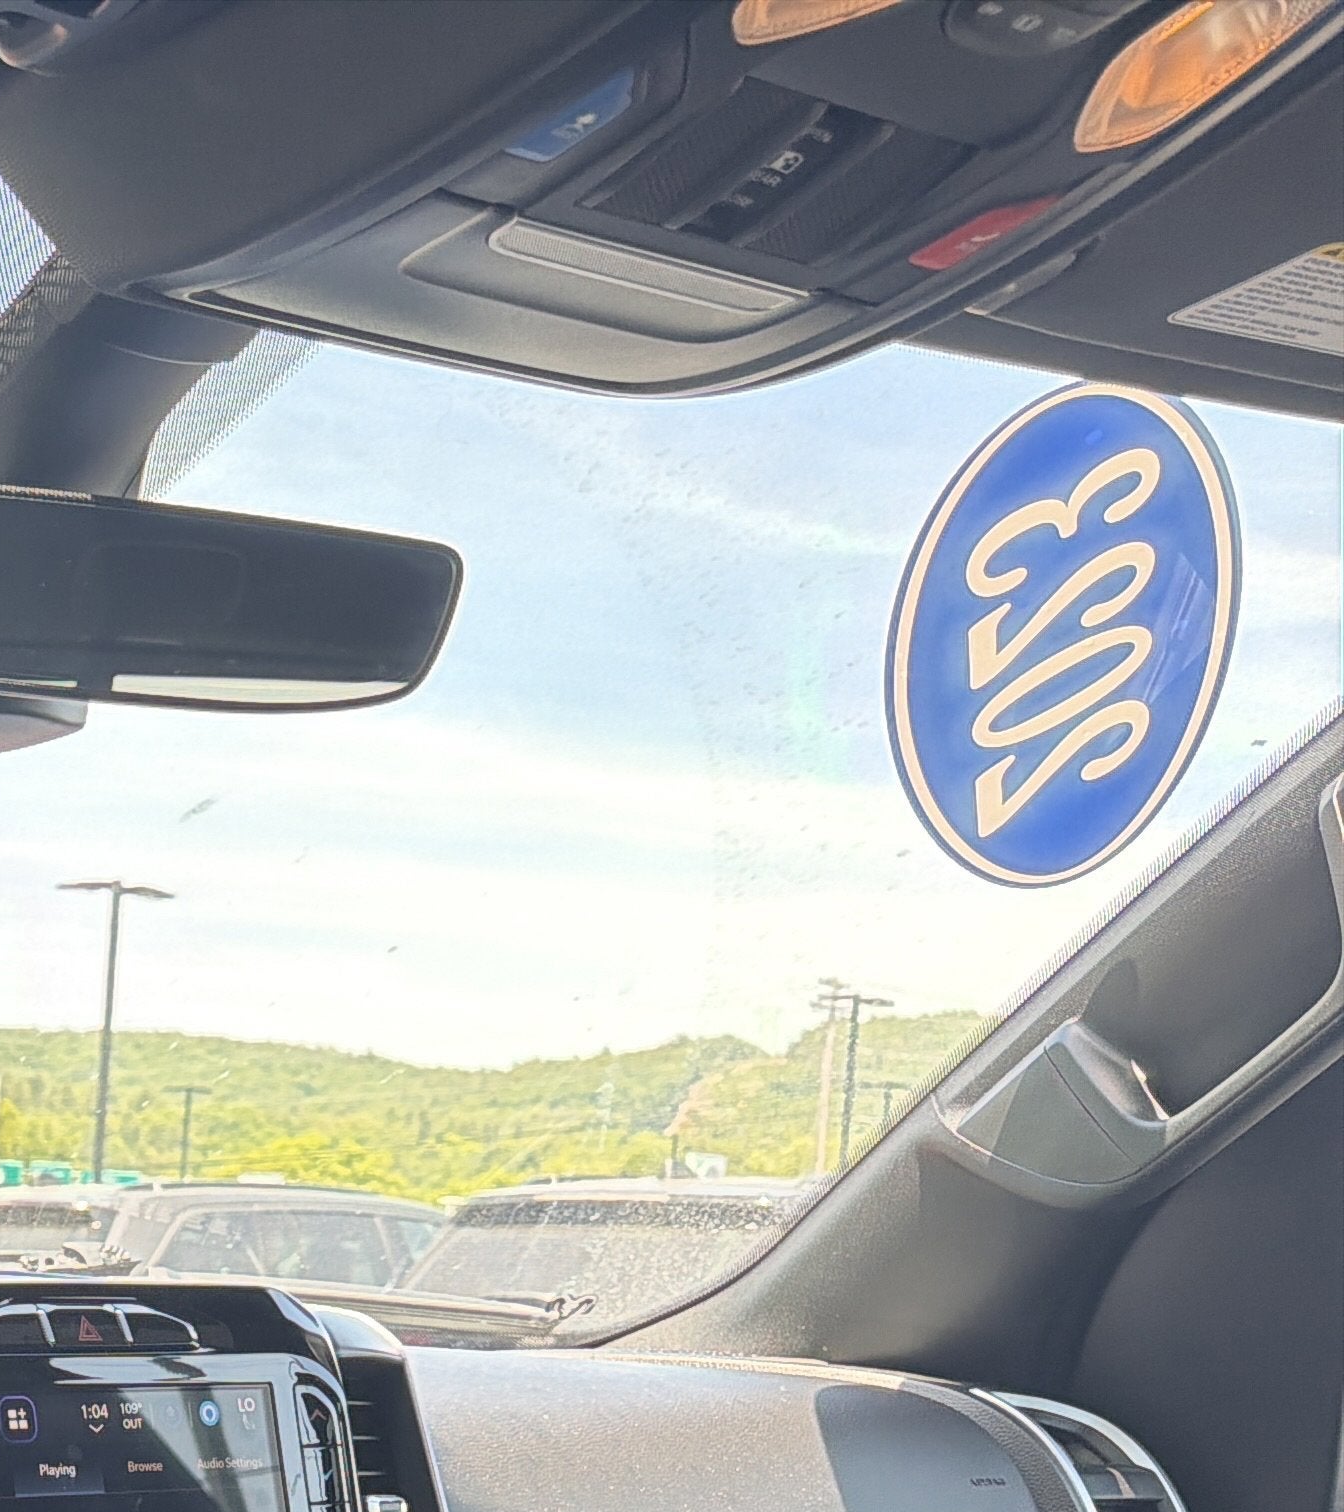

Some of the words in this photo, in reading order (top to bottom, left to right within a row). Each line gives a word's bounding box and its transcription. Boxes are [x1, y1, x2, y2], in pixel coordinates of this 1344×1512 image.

[81, 1404, 109, 1420] 1:04
[237, 1397, 255, 1413] LO
[122, 1418, 143, 1430] OUT
[38, 1462, 76, 1478] Playing
[127, 1460, 163, 1473] Browse
[197, 1457, 224, 1470] Audio
[225, 1456, 263, 1470] Settings
